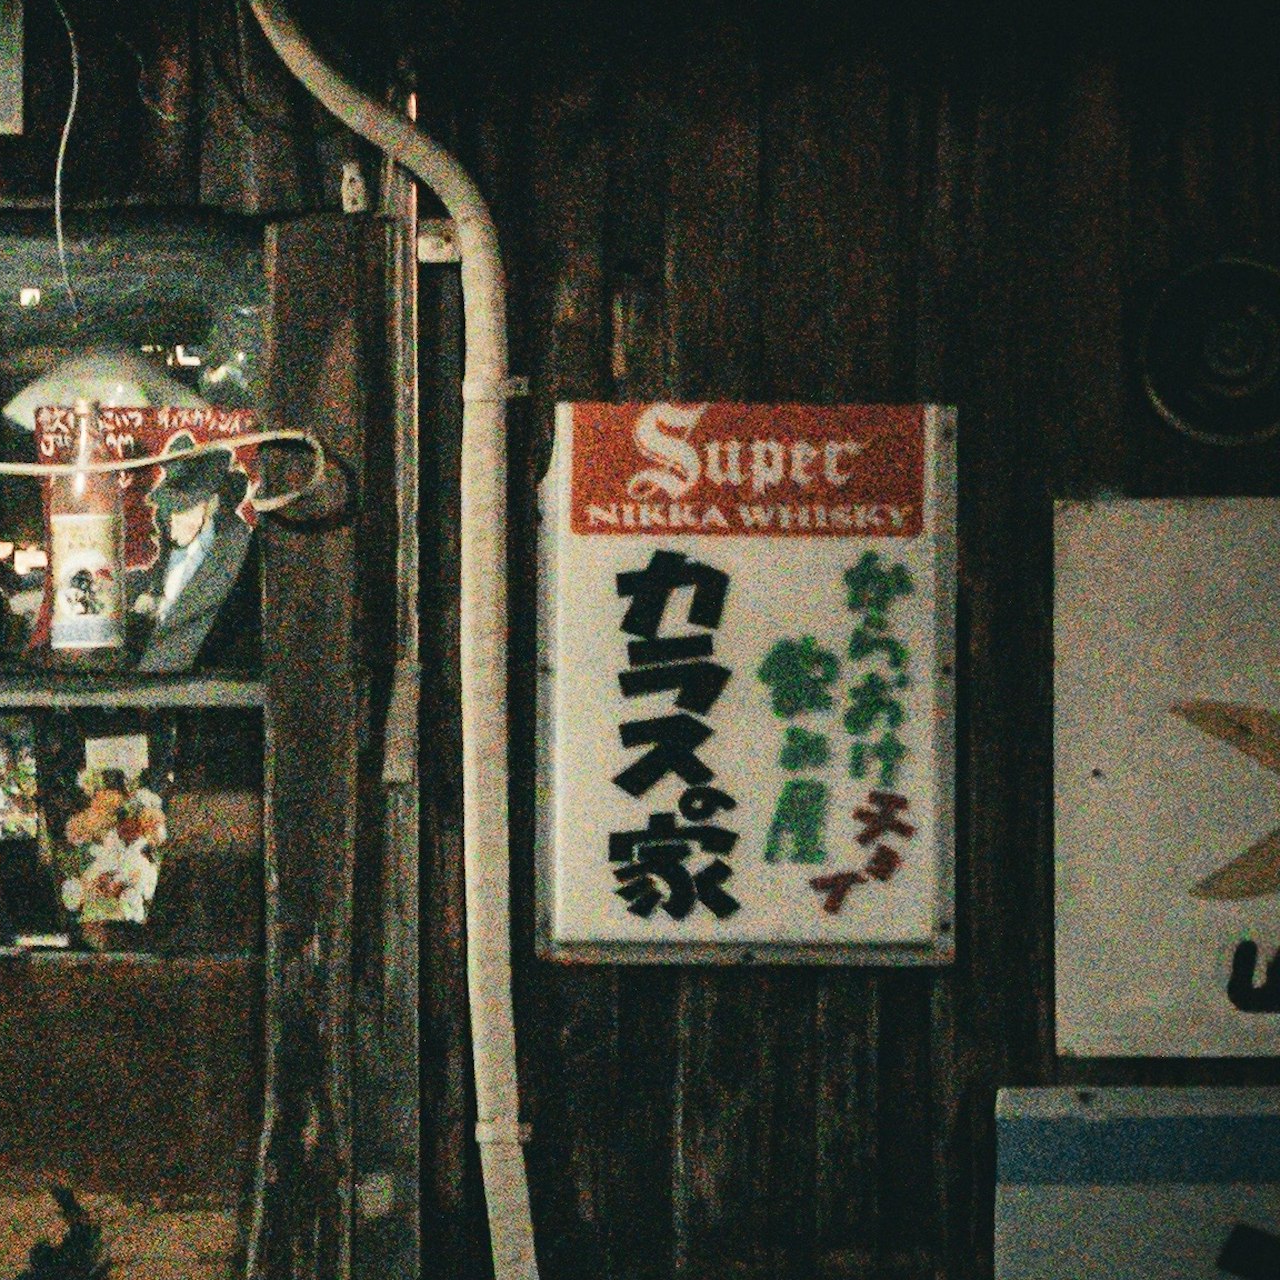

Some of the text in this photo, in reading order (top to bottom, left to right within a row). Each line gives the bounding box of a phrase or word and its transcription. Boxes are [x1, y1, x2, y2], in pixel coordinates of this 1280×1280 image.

[627, 402, 872, 502] Super
[585, 503, 912, 530] NIKKA WHISKY
[608, 548, 741, 921] カラスの家
